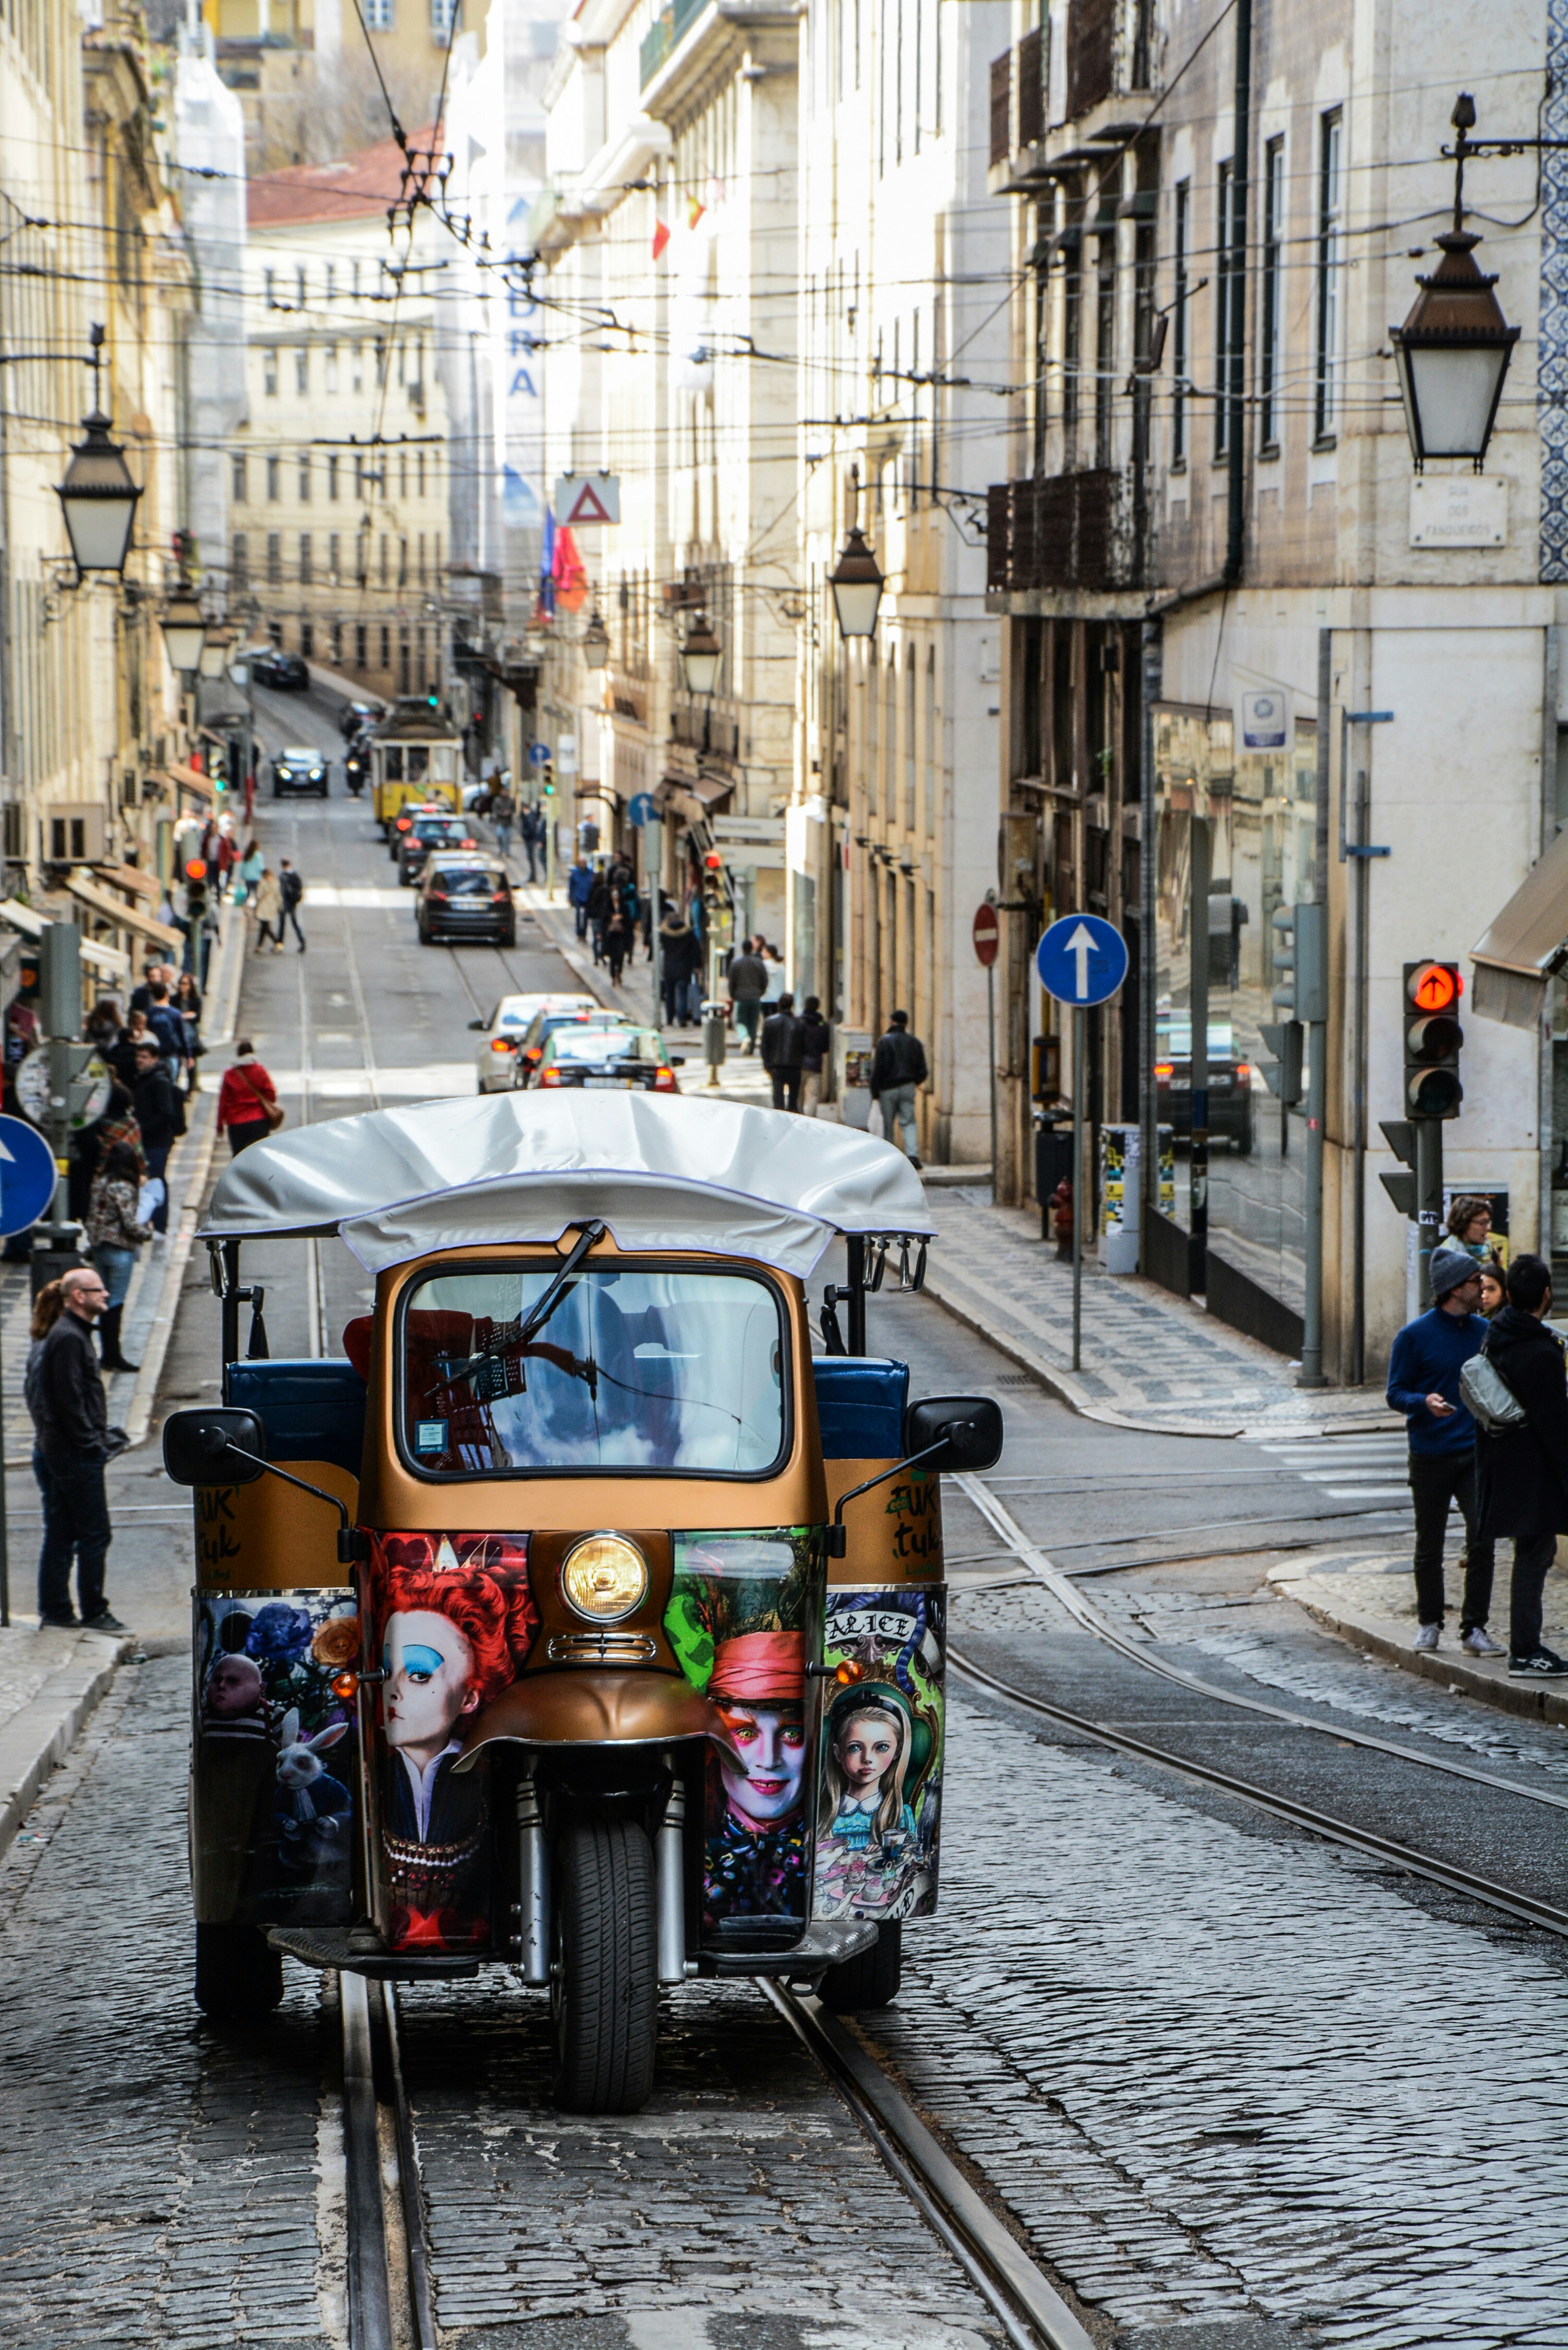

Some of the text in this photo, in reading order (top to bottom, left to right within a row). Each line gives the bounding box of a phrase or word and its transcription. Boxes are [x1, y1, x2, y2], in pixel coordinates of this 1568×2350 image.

[1448, 504, 1469, 516] DOS
[197, 1488, 236, 1523] UK
[890, 1499, 907, 1511] eco
[825, 1613, 909, 1639] ALICE
